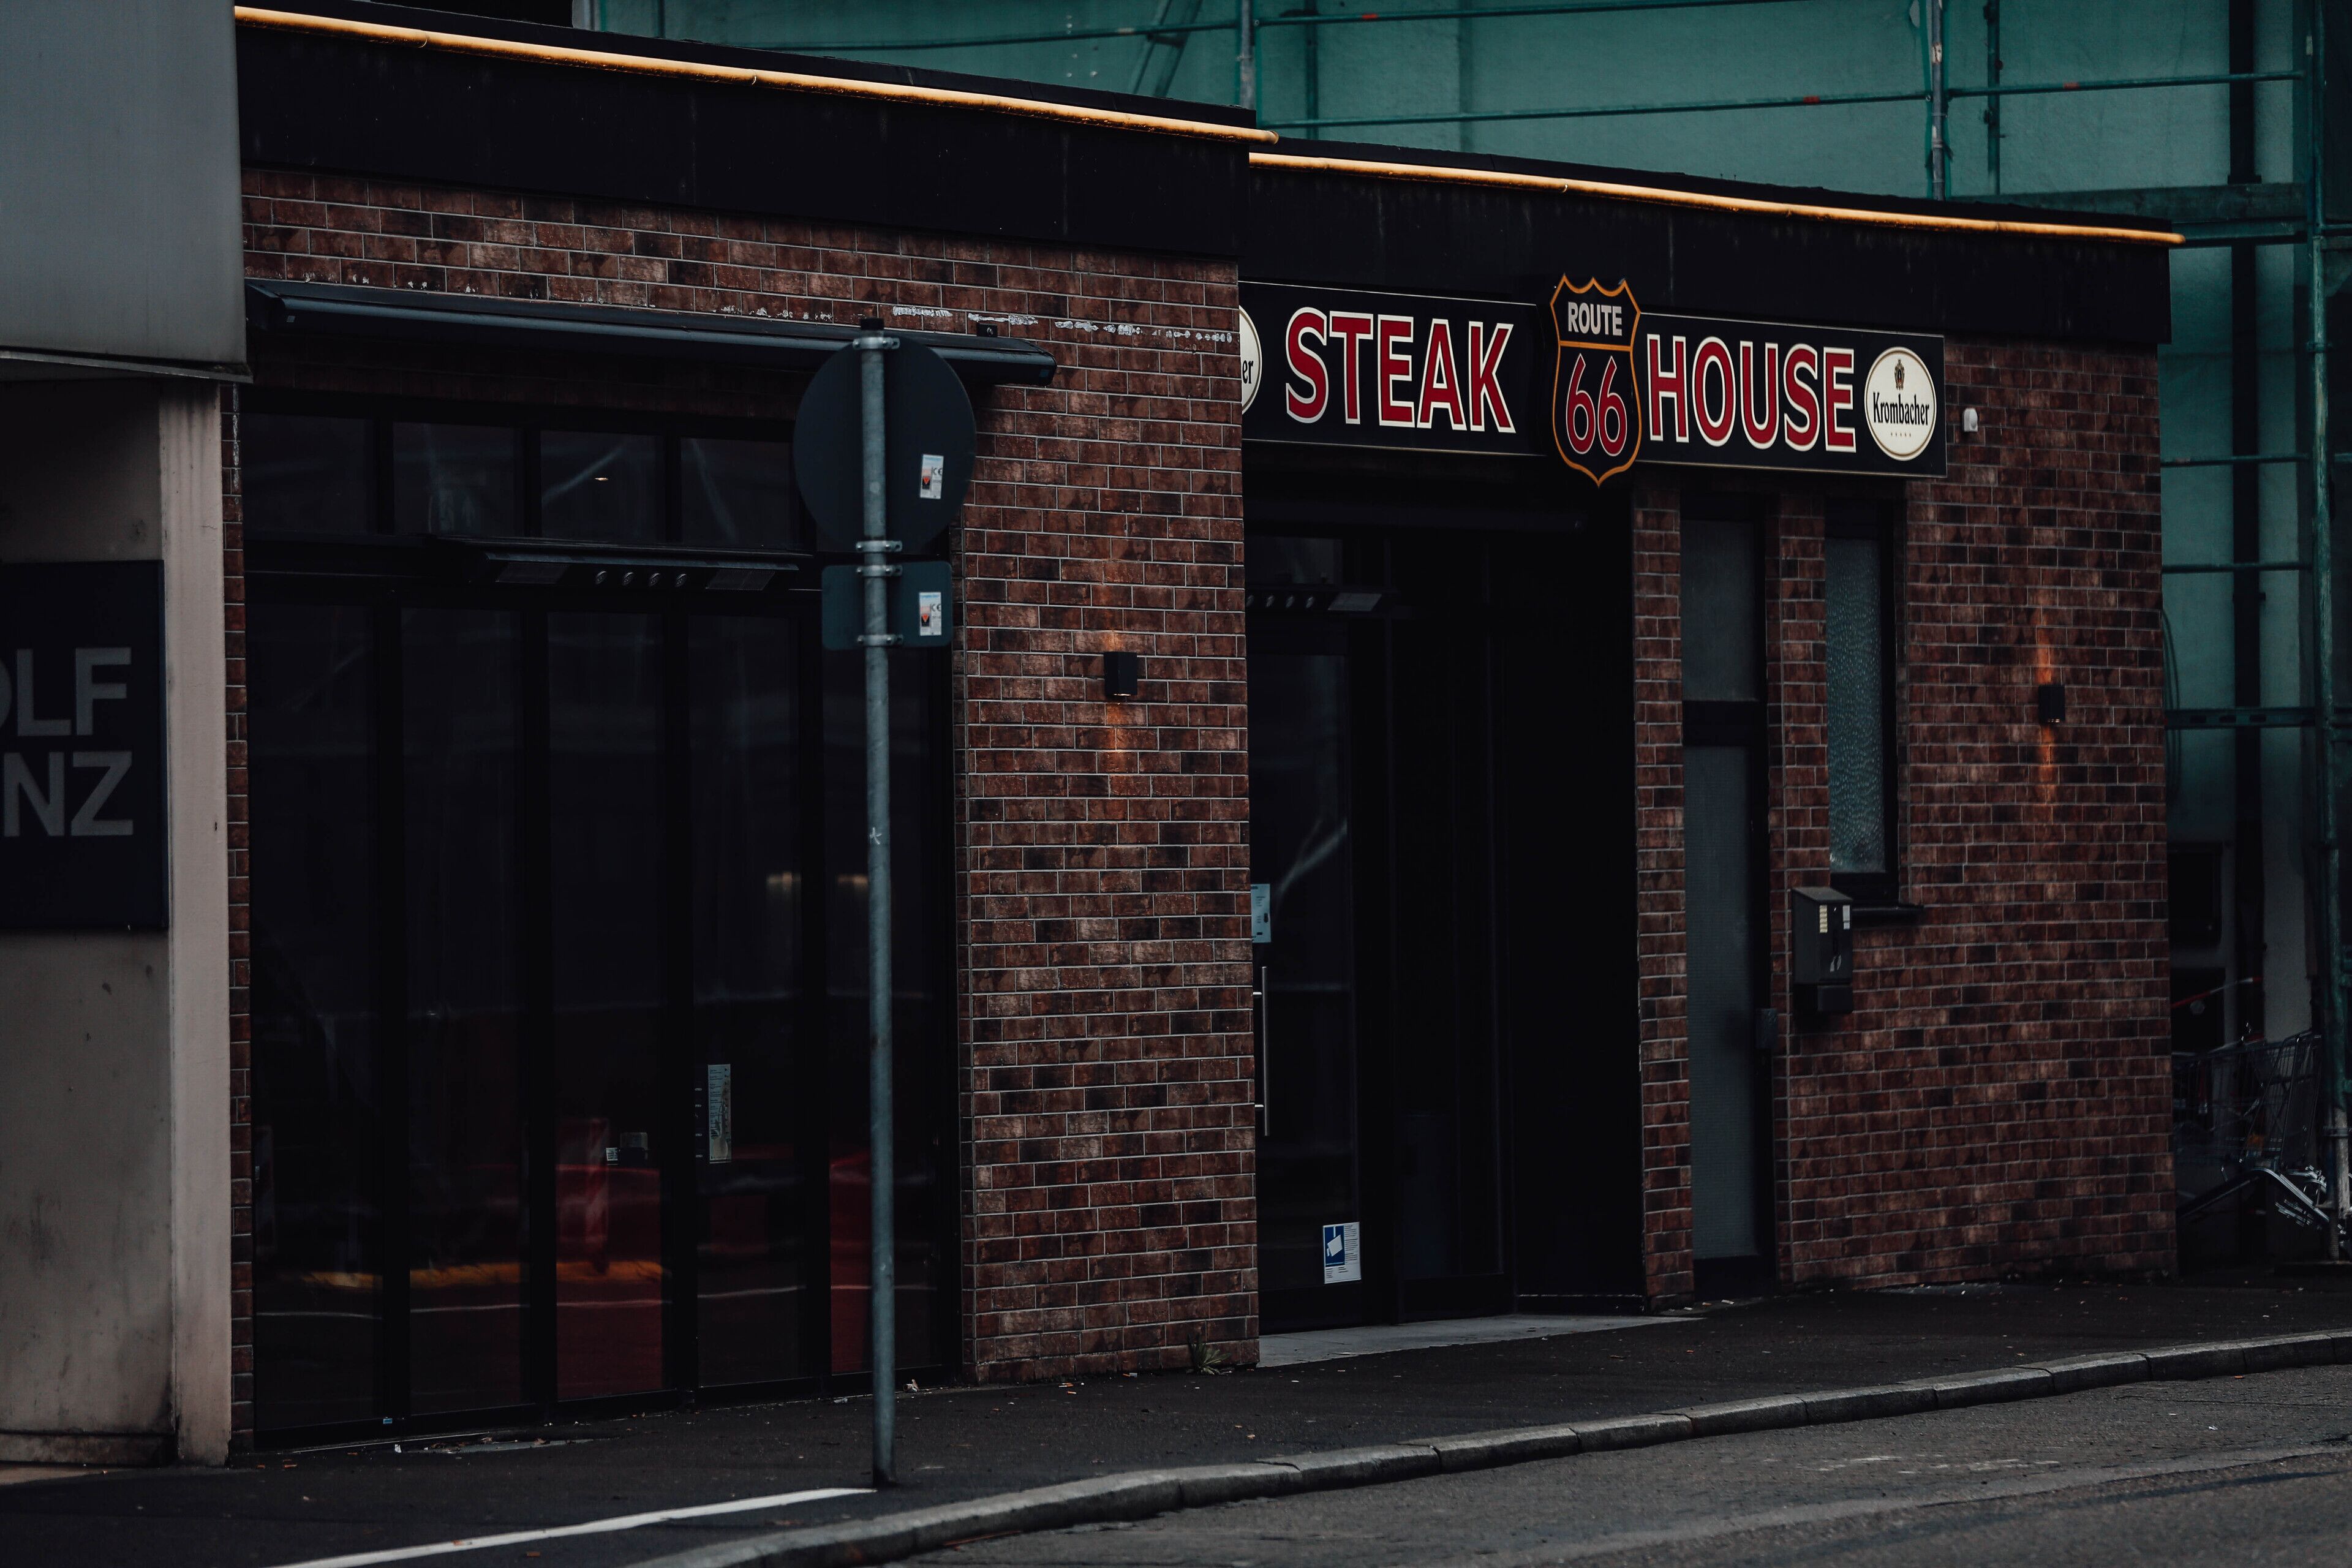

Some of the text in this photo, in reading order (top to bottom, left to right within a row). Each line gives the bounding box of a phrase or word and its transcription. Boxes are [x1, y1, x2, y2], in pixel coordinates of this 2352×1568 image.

[1567, 301, 1623, 336] ROUTE
[1286, 306, 1856, 453] STEAK HOUSE
[1566, 353, 1627, 456] 66
[1873, 392, 1929, 426] Krombacher
[0, 647, 132, 736] LF
[3, 750, 134, 837] NZ
